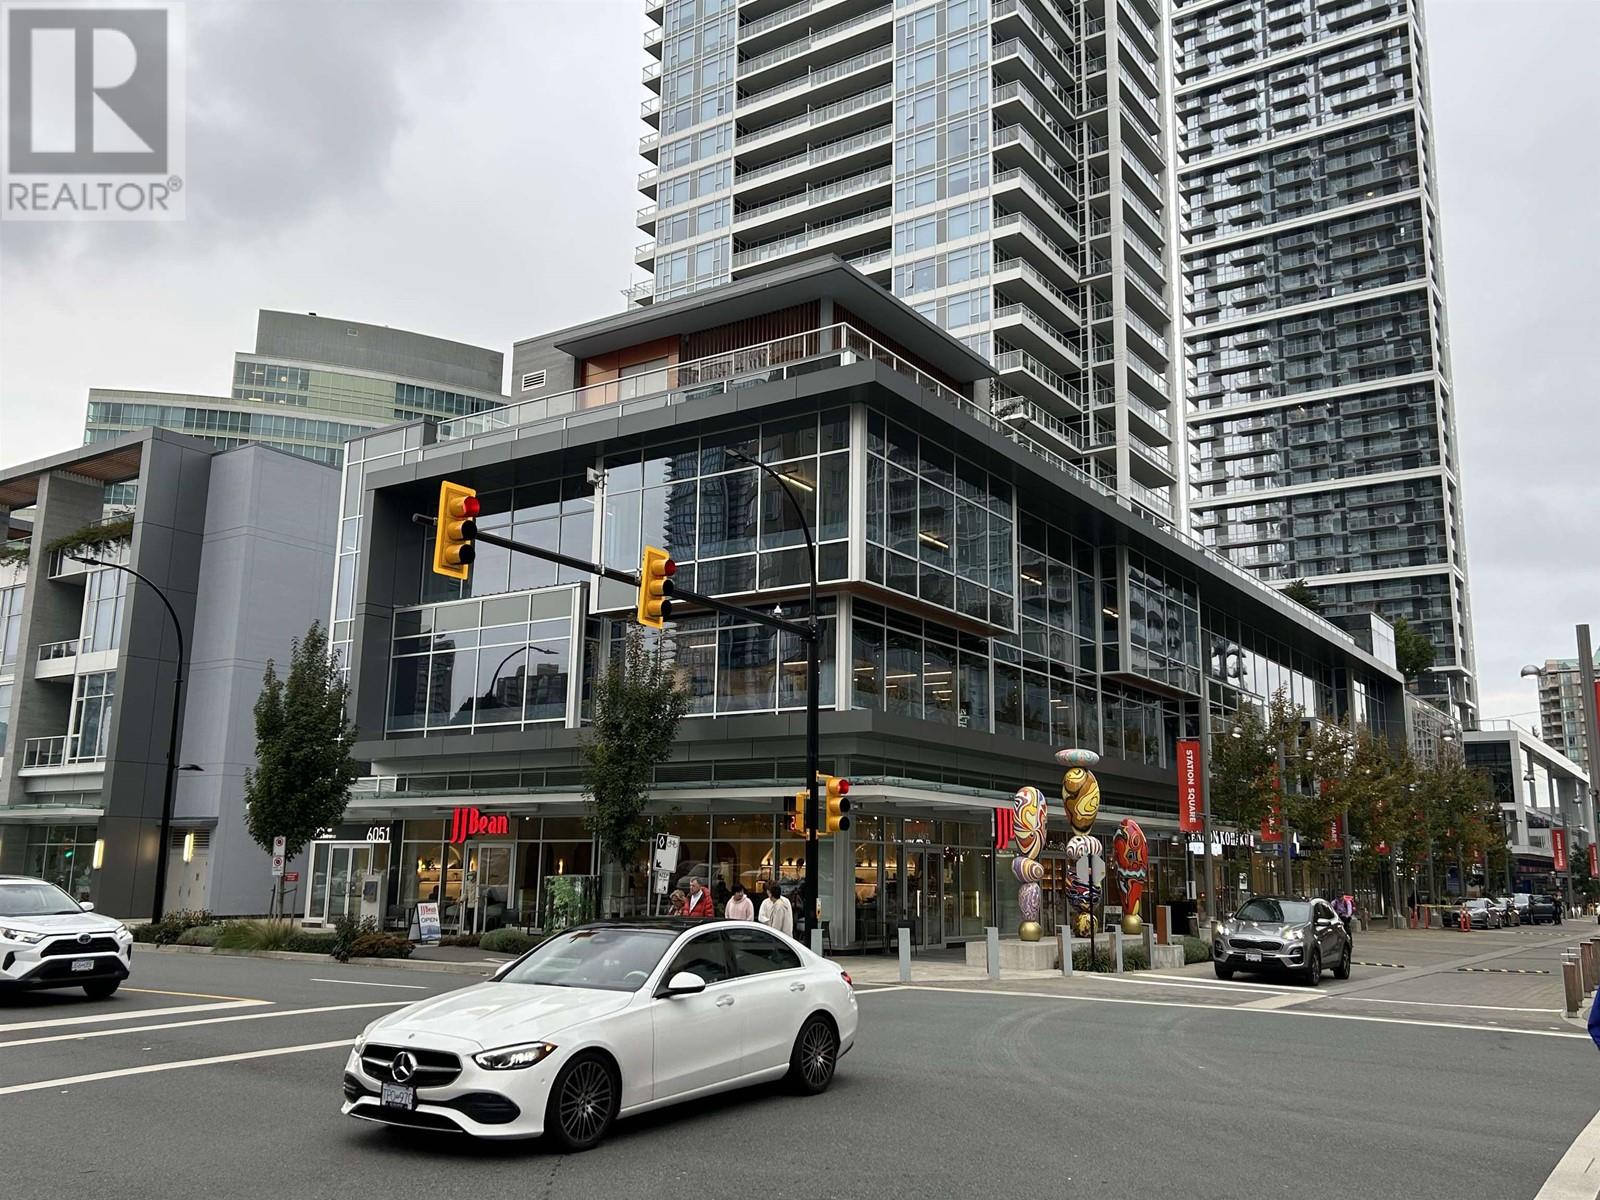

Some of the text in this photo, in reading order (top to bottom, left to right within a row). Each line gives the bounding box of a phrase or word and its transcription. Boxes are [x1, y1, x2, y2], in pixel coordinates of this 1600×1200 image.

[1186, 749, 1197, 823] STATION SQUARE
[367, 826, 390, 841] 6051
